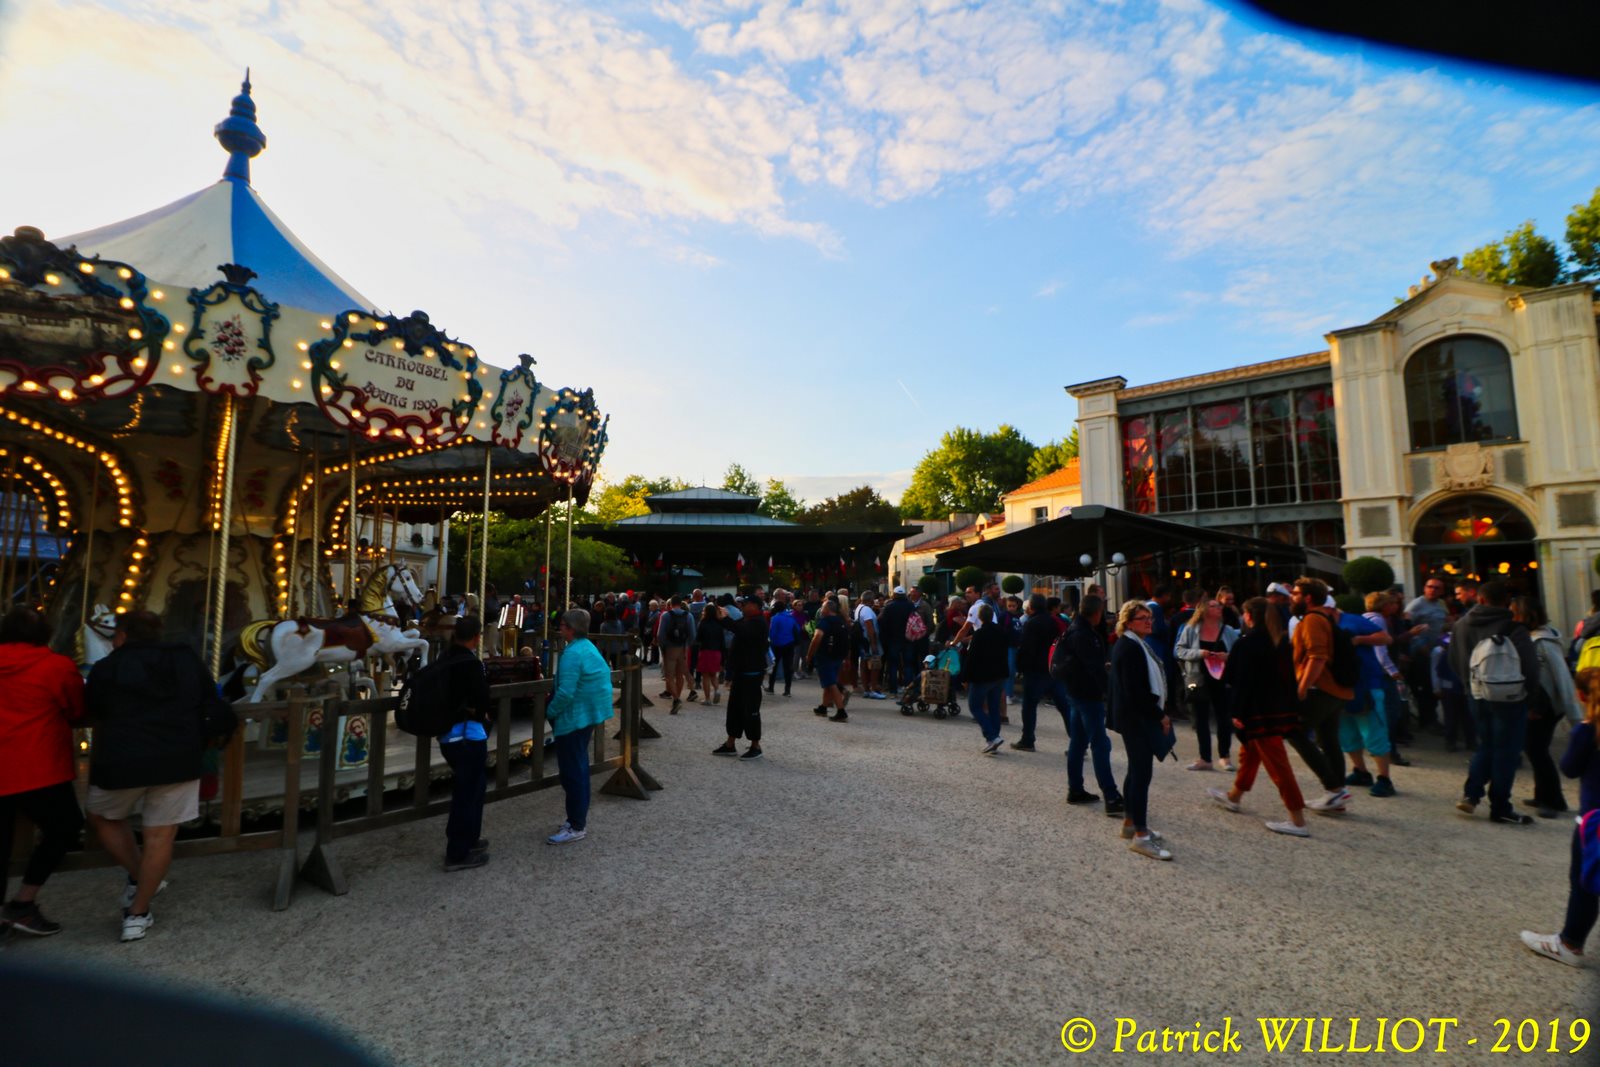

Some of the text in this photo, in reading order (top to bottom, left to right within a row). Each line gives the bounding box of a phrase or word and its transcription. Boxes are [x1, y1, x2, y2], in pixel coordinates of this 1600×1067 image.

[365, 350, 448, 381] CARROUSEL
[363, 381, 438, 411] BOURG 1900
[396, 376, 416, 391] DU
